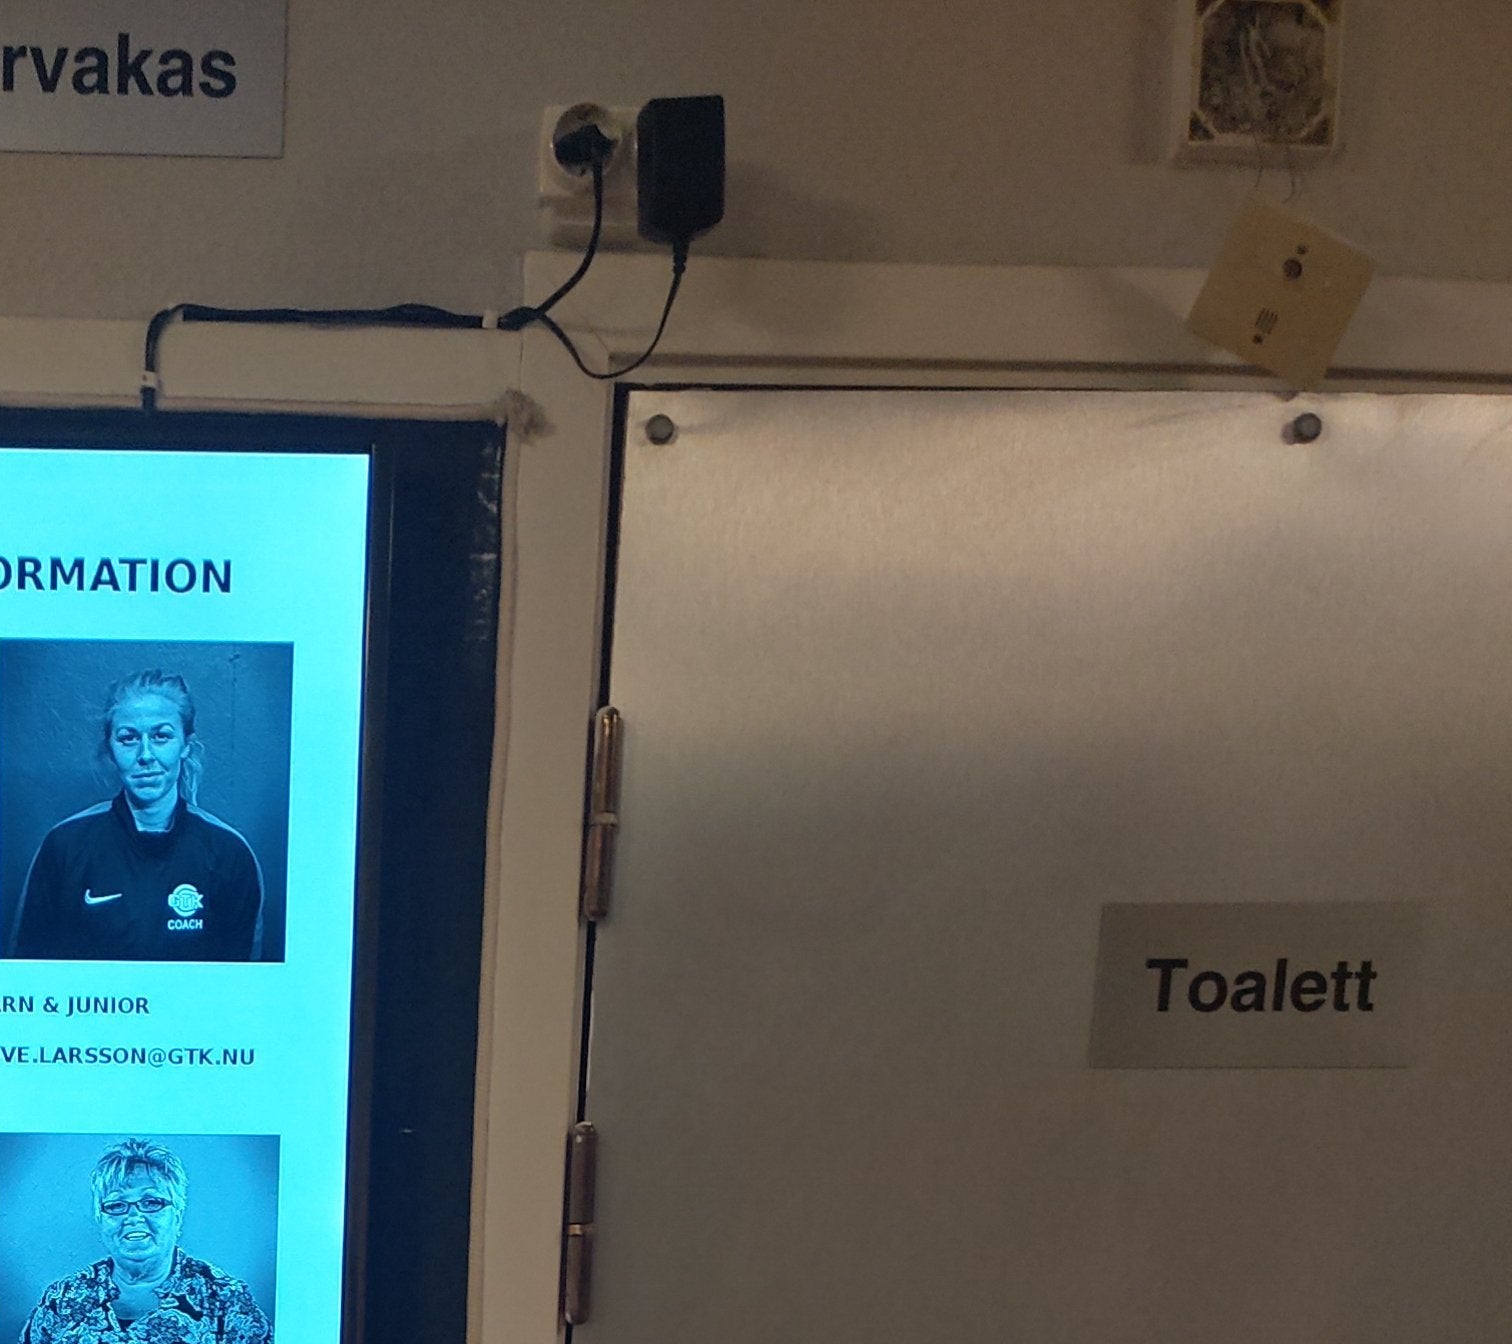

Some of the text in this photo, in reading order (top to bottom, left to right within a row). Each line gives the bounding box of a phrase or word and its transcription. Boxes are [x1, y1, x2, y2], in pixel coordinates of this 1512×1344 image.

[167, 919, 203, 930] COACH
[1146, 958, 1377, 1012] Toalett
[43, 997, 58, 1012] &
[66, 997, 149, 1017] JUNIOR
